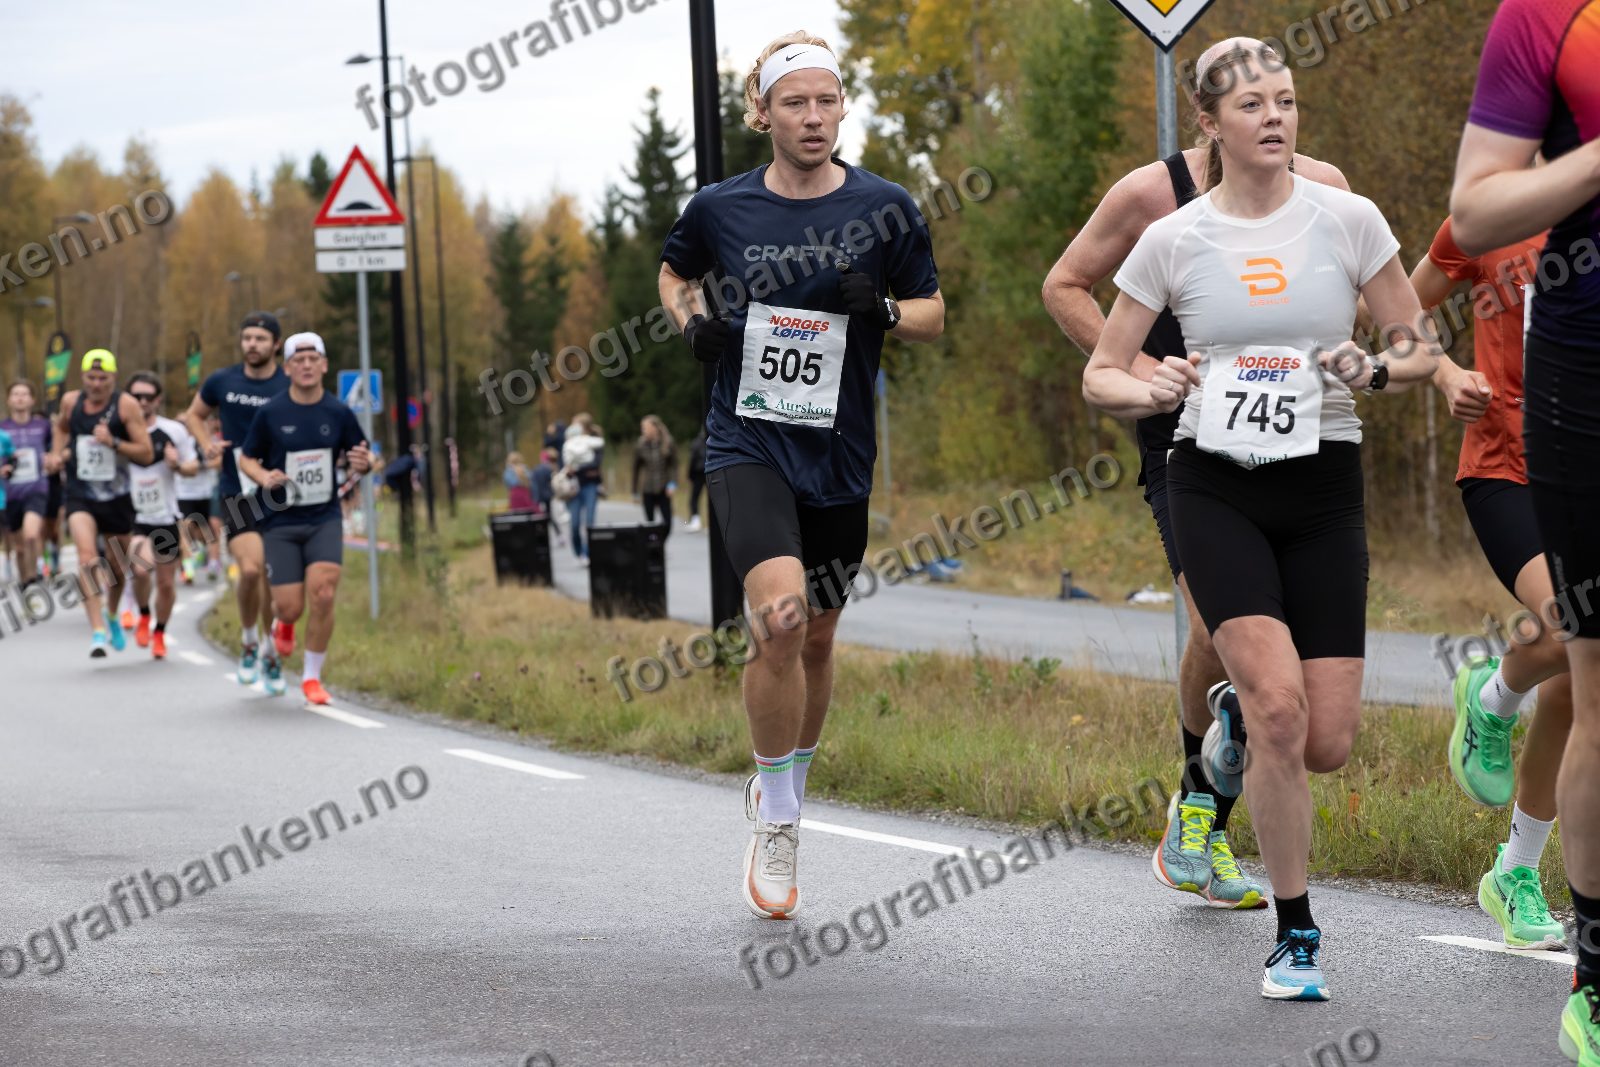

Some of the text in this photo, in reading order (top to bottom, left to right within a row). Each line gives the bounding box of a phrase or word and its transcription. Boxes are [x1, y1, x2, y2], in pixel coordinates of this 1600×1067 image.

[743, 244, 833, 262] CRAFT
[769, 315, 830, 332] NORGES
[771, 326, 819, 342] LØPET
[758, 345, 823, 386] 505
[1233, 355, 1302, 370] NORGES
[1237, 369, 1290, 382] LØPET
[775, 398, 833, 418] Aurskog
[1225, 391, 1297, 435] 745
[296, 468, 323, 485] 405
